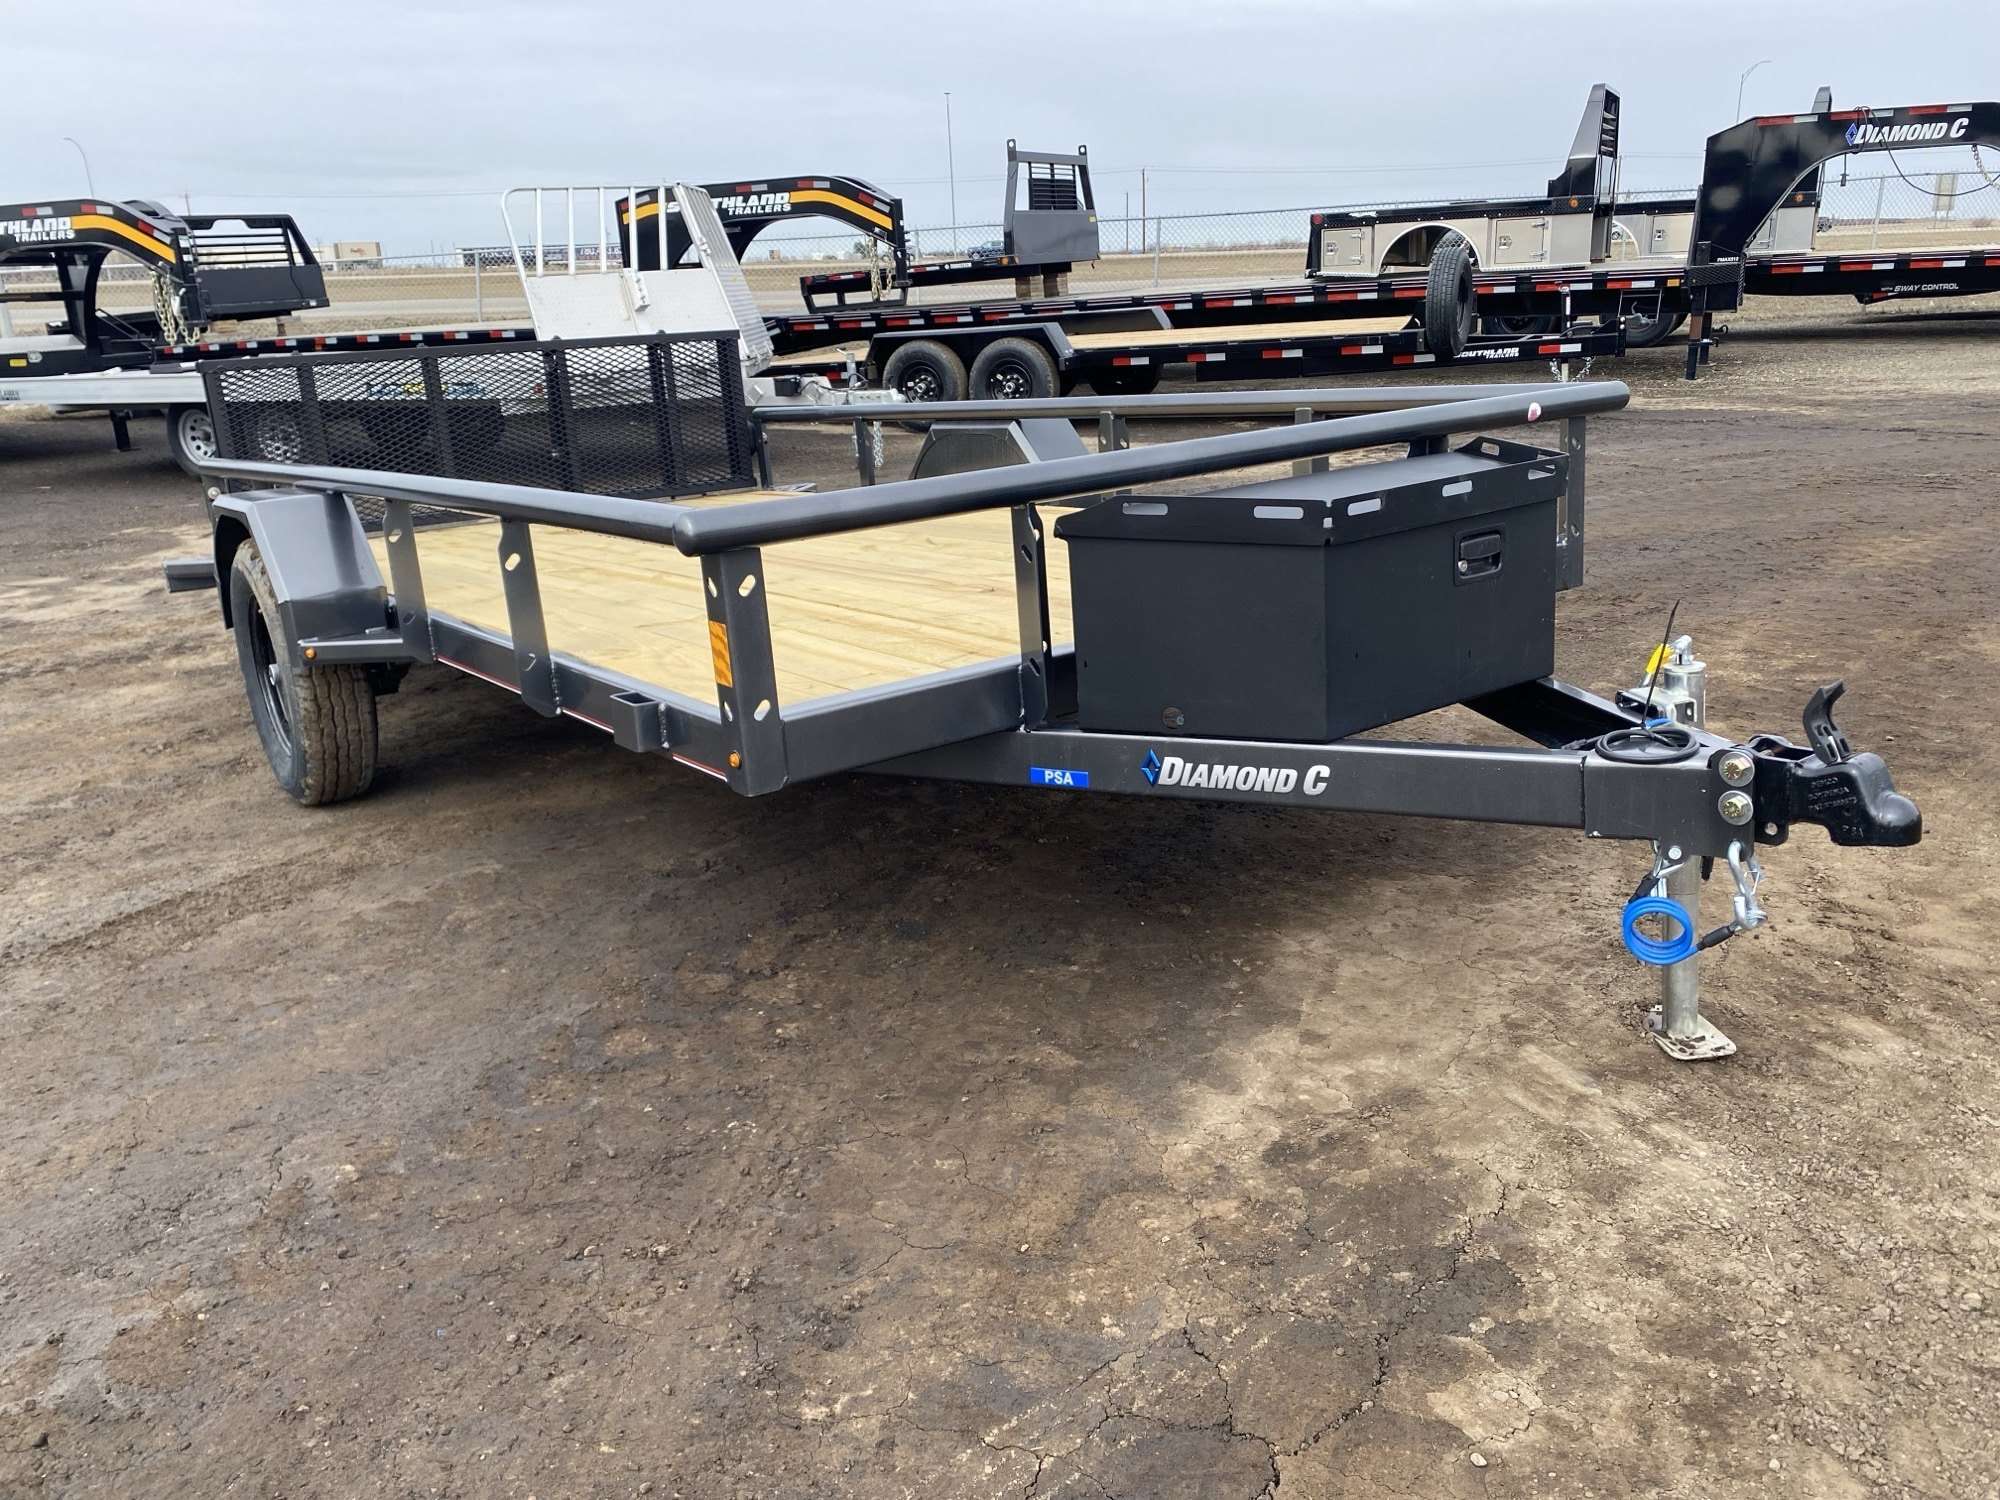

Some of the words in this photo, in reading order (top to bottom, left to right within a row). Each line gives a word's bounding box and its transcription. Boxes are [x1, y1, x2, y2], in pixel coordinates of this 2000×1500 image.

[1854, 122, 1948, 145] DIAMOND
[1949, 117, 1969, 139] C
[666, 191, 790, 214] STHLAND
[727, 203, 792, 216] TRAILERS
[0, 216, 72, 236] THLAND
[14, 228, 76, 243] TRAILERS
[1894, 284, 1920, 292] SWAY
[1921, 282, 1959, 291] CONTROL
[1044, 771, 1074, 785] PSA
[1158, 756, 1298, 794] DIAMOND
[1302, 765, 1331, 796] C
